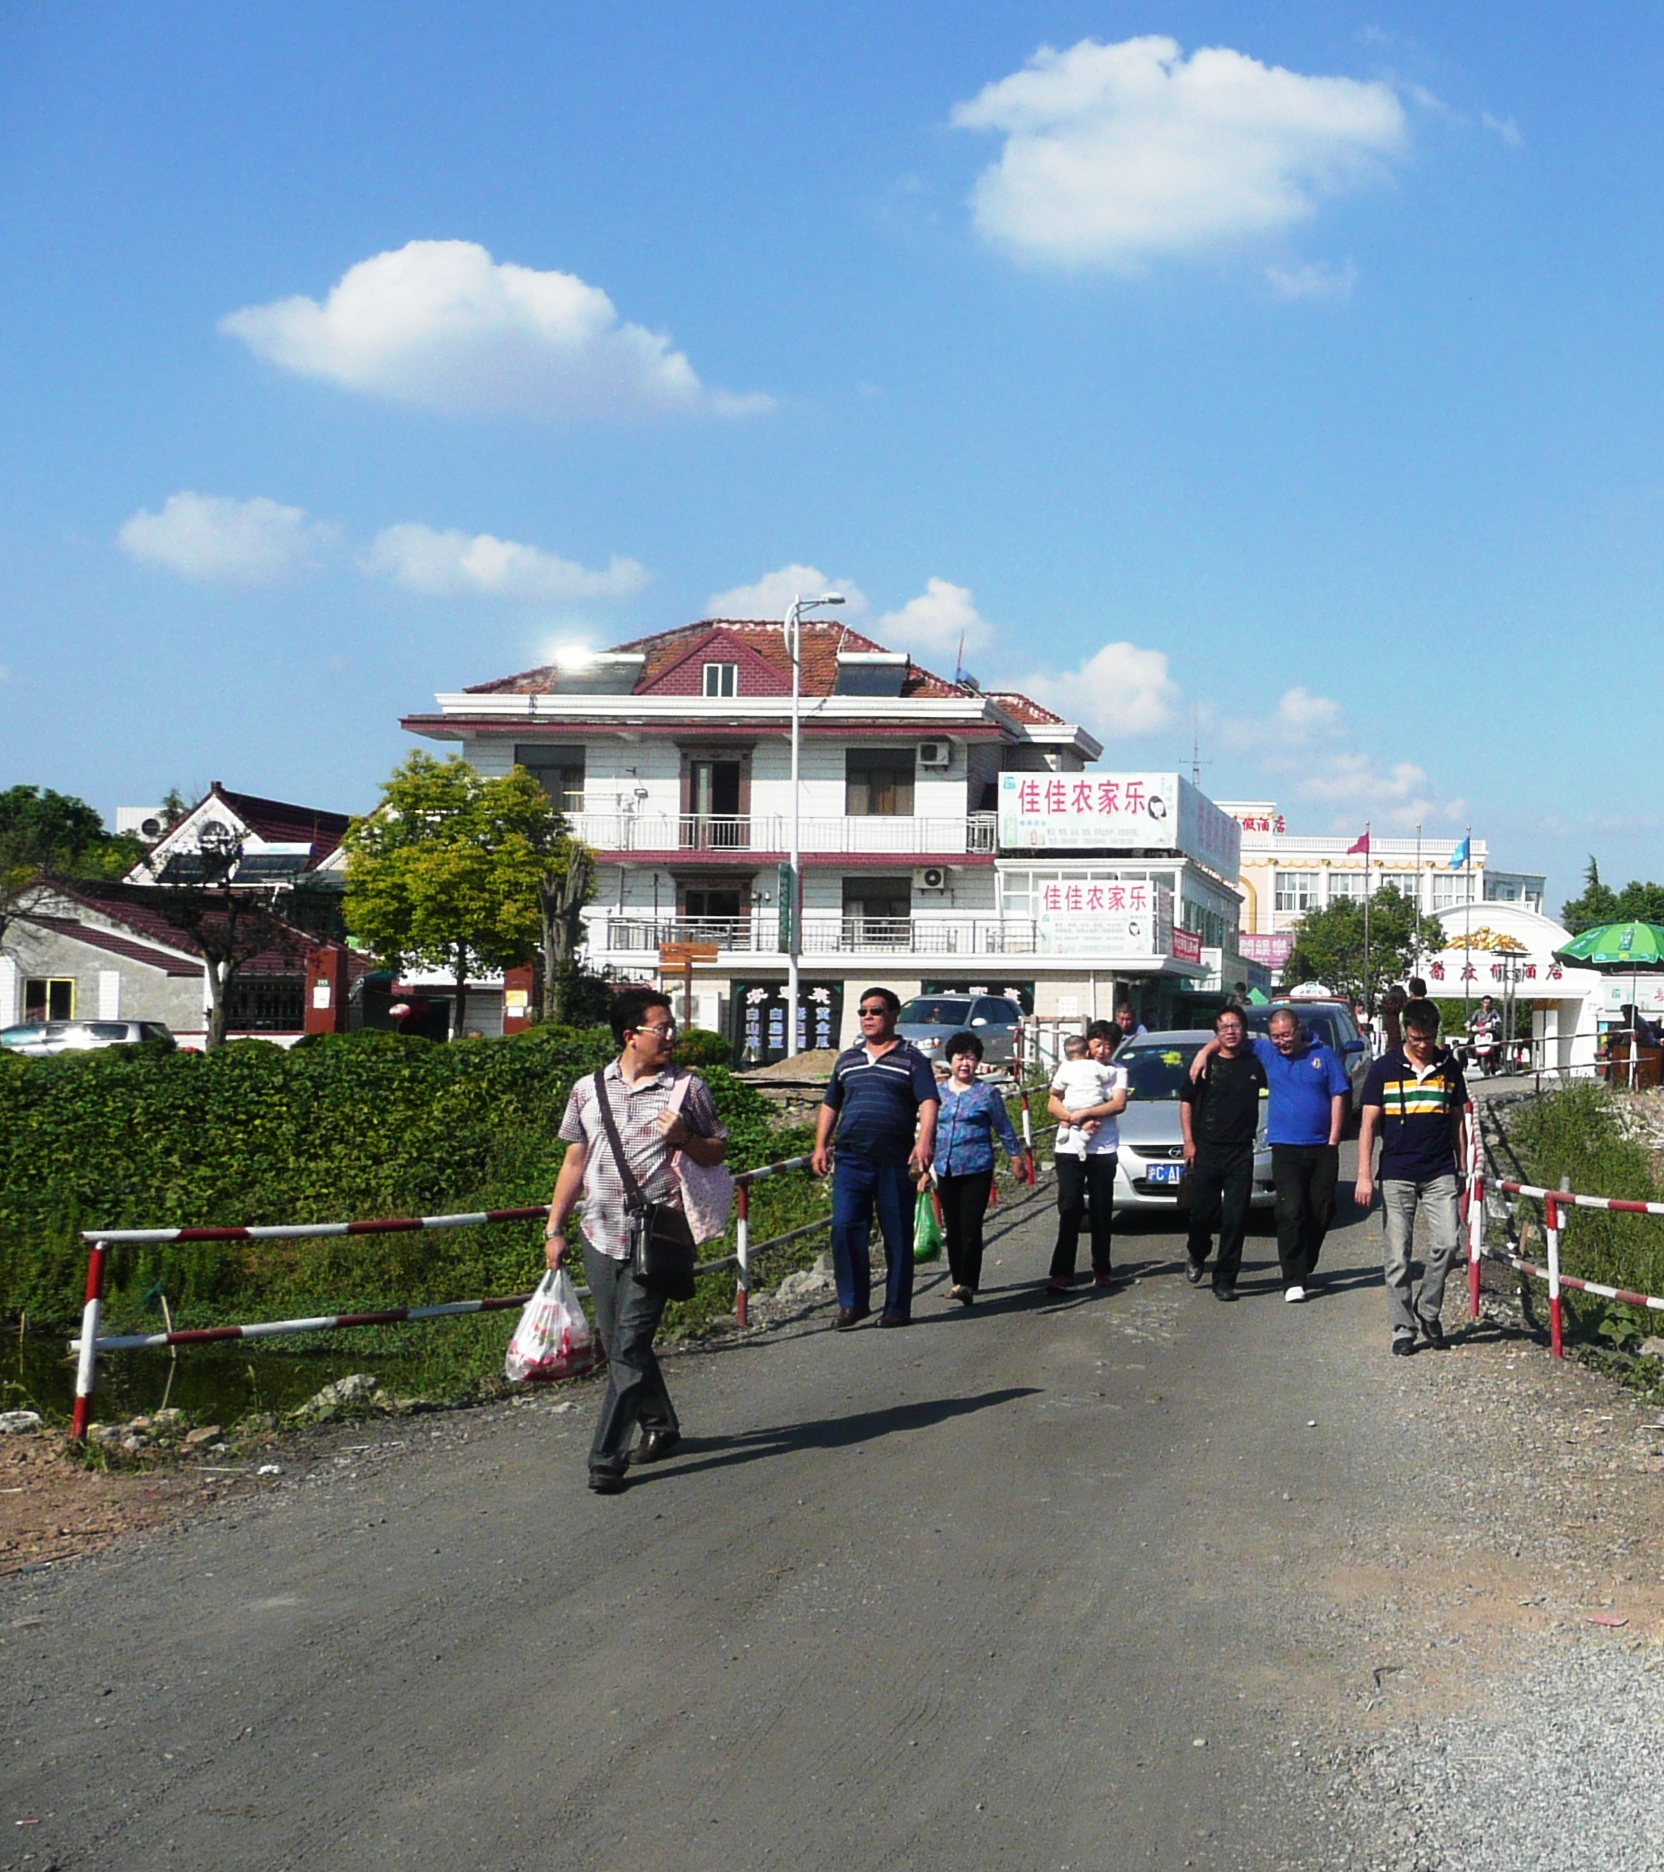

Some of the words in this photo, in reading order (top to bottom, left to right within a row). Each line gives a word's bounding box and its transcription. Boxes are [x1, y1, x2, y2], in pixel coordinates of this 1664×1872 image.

[1018, 779, 1147, 815] 佳佳农家乐
[1043, 884, 1147, 912] 佳佳农家乐
